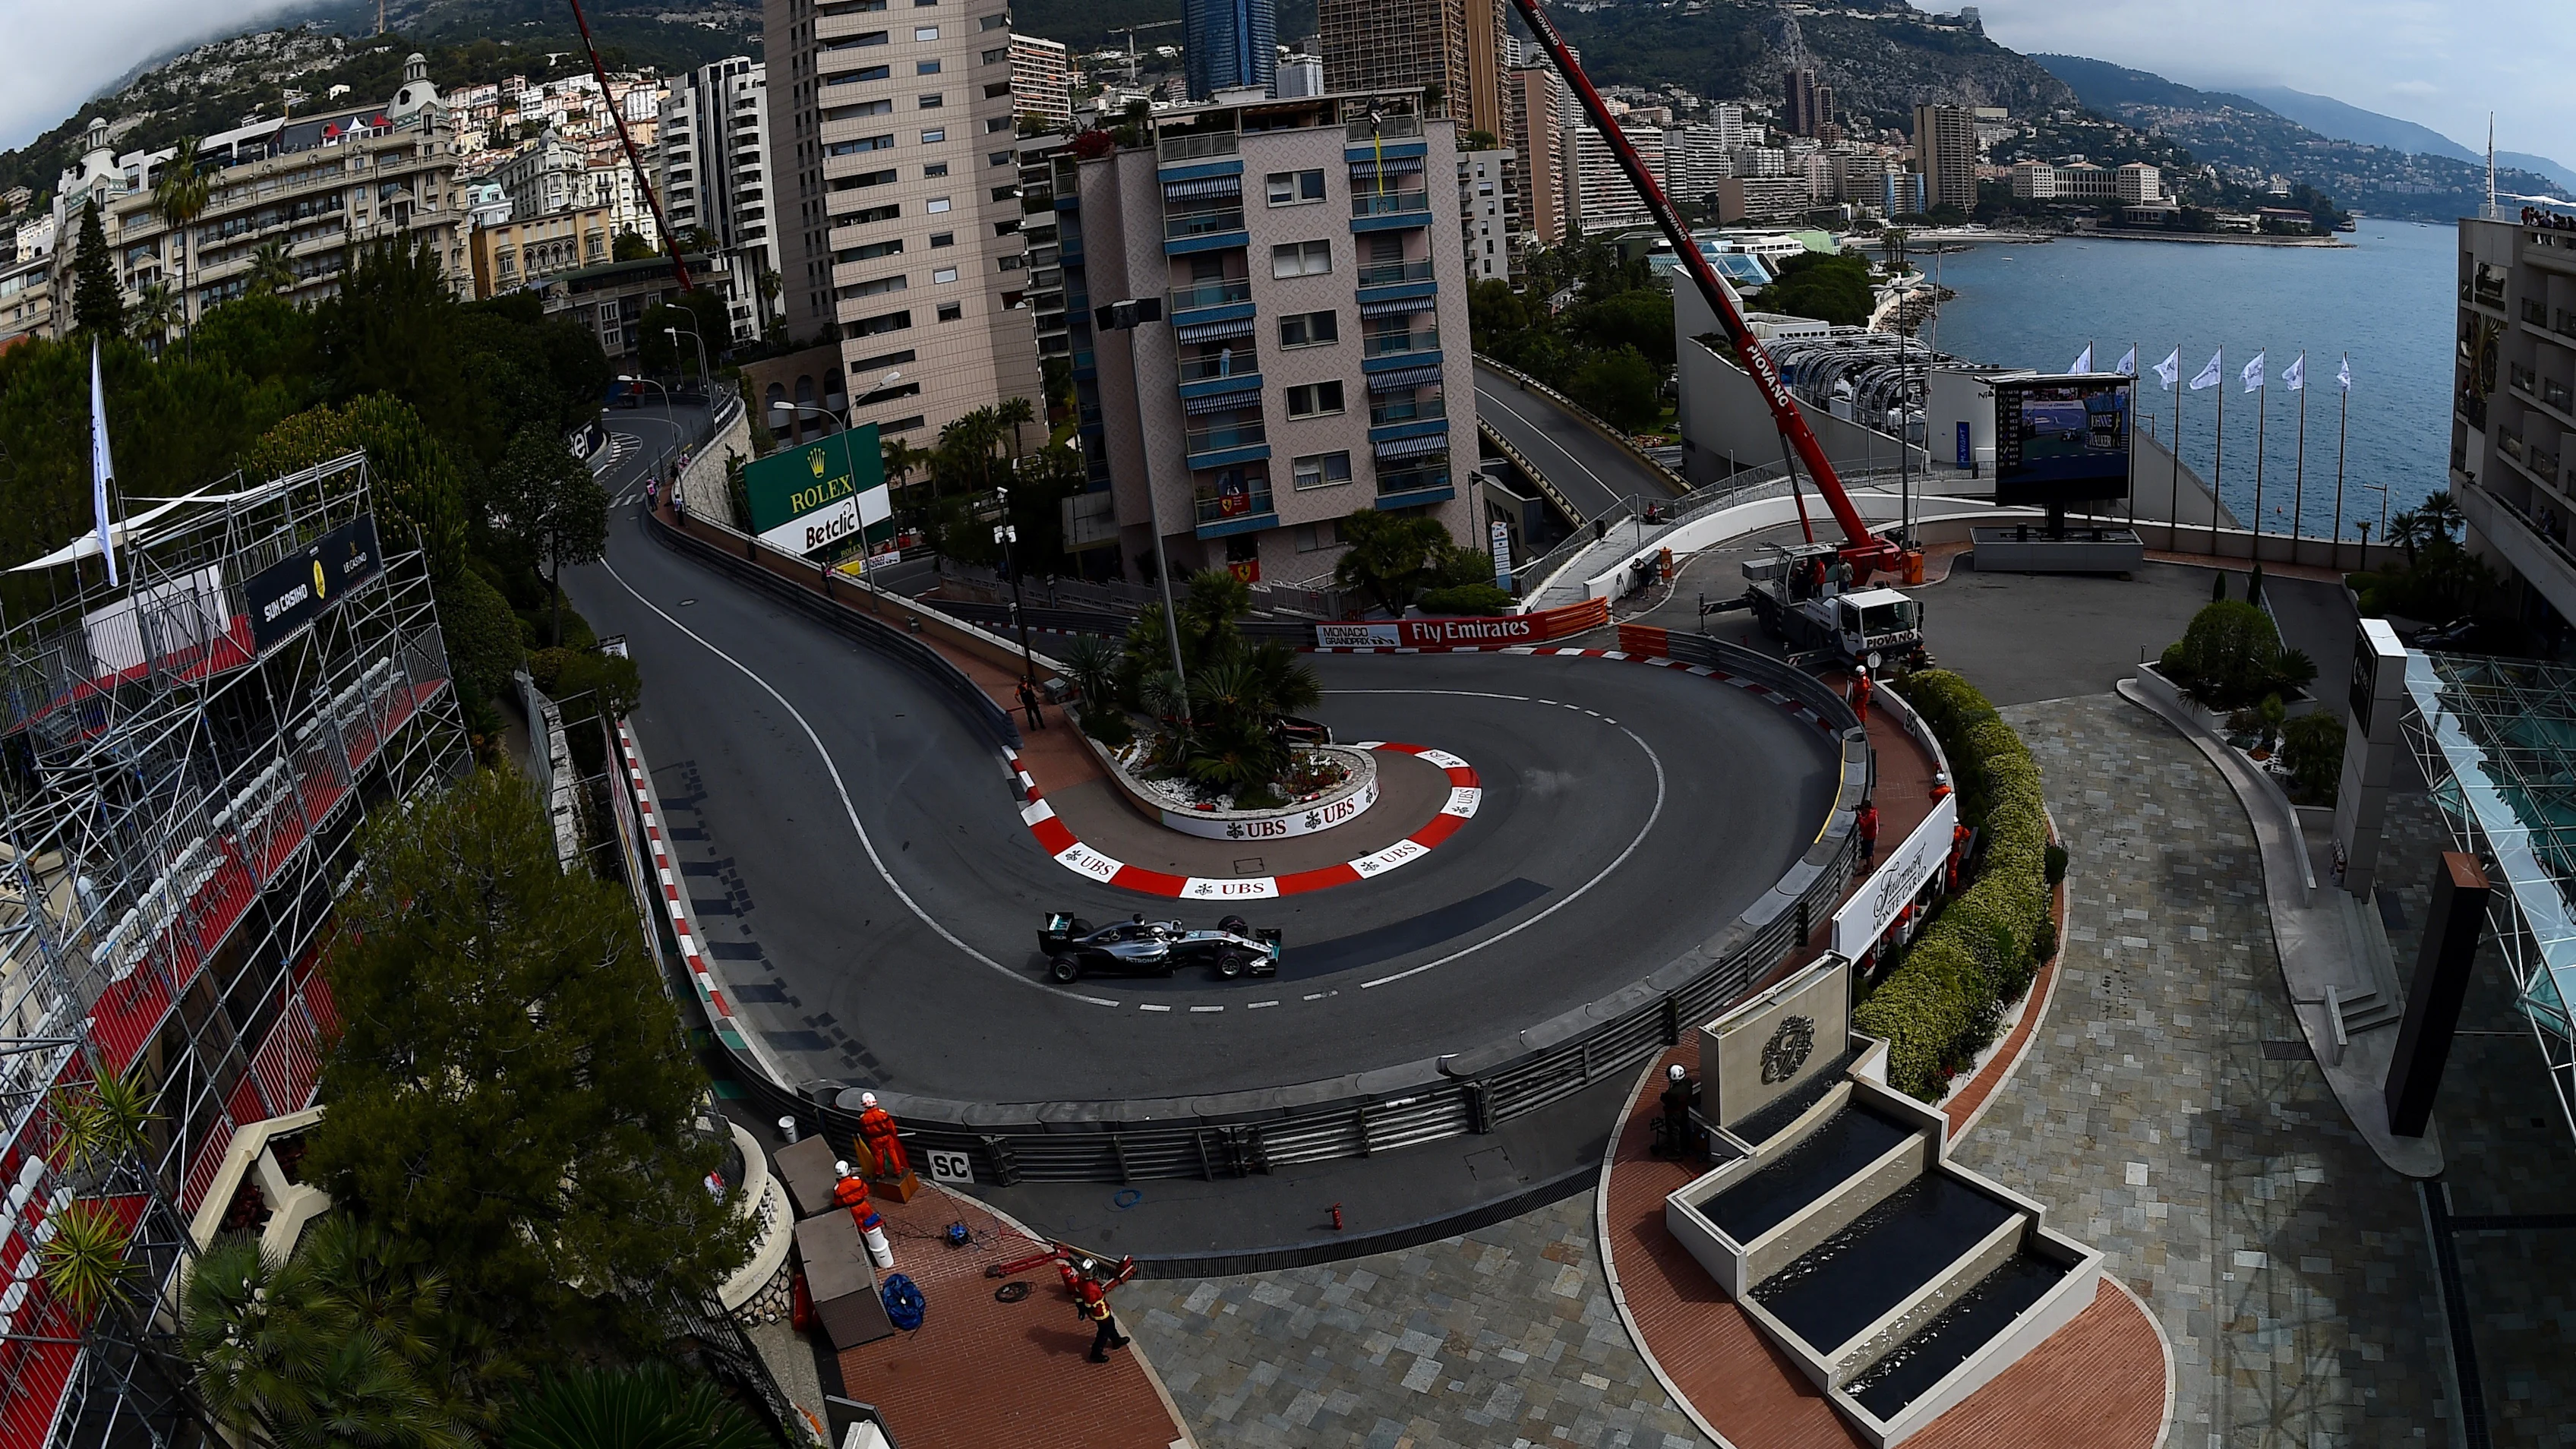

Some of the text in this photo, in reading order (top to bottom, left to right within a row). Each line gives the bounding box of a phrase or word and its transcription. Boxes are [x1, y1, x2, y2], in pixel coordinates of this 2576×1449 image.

[1532, 8, 1559, 46] PIOVANO
[1662, 204, 1687, 241] PIOVANO
[1747, 345, 1789, 407] PIOVANO
[2089, 431, 2111, 447] WALKER
[790, 474, 853, 513] ROLEX
[806, 510, 855, 549] Betclic
[841, 544, 863, 557] ROLEX
[343, 562, 350, 573] LE
[349, 552, 367, 570] CASINO
[264, 583, 308, 622] SUN CASINO
[1323, 627, 1368, 637] MONACO
[1412, 620, 1530, 642] Fly Emirates
[1867, 631, 1915, 648] PIOVANO
[1905, 712, 1916, 732] SC
[1457, 788, 1475, 804] UBS
[1323, 798, 1355, 823] UBS
[1245, 819, 1286, 837] UBS
[1378, 844, 1417, 863] UBS
[1081, 855, 1114, 876] UBS
[1221, 883, 1264, 895] UBS
[1874, 841, 1927, 917] Fairmont
[1872, 866, 1927, 936] MONTE CARLO
[933, 1155, 968, 1178] SC
